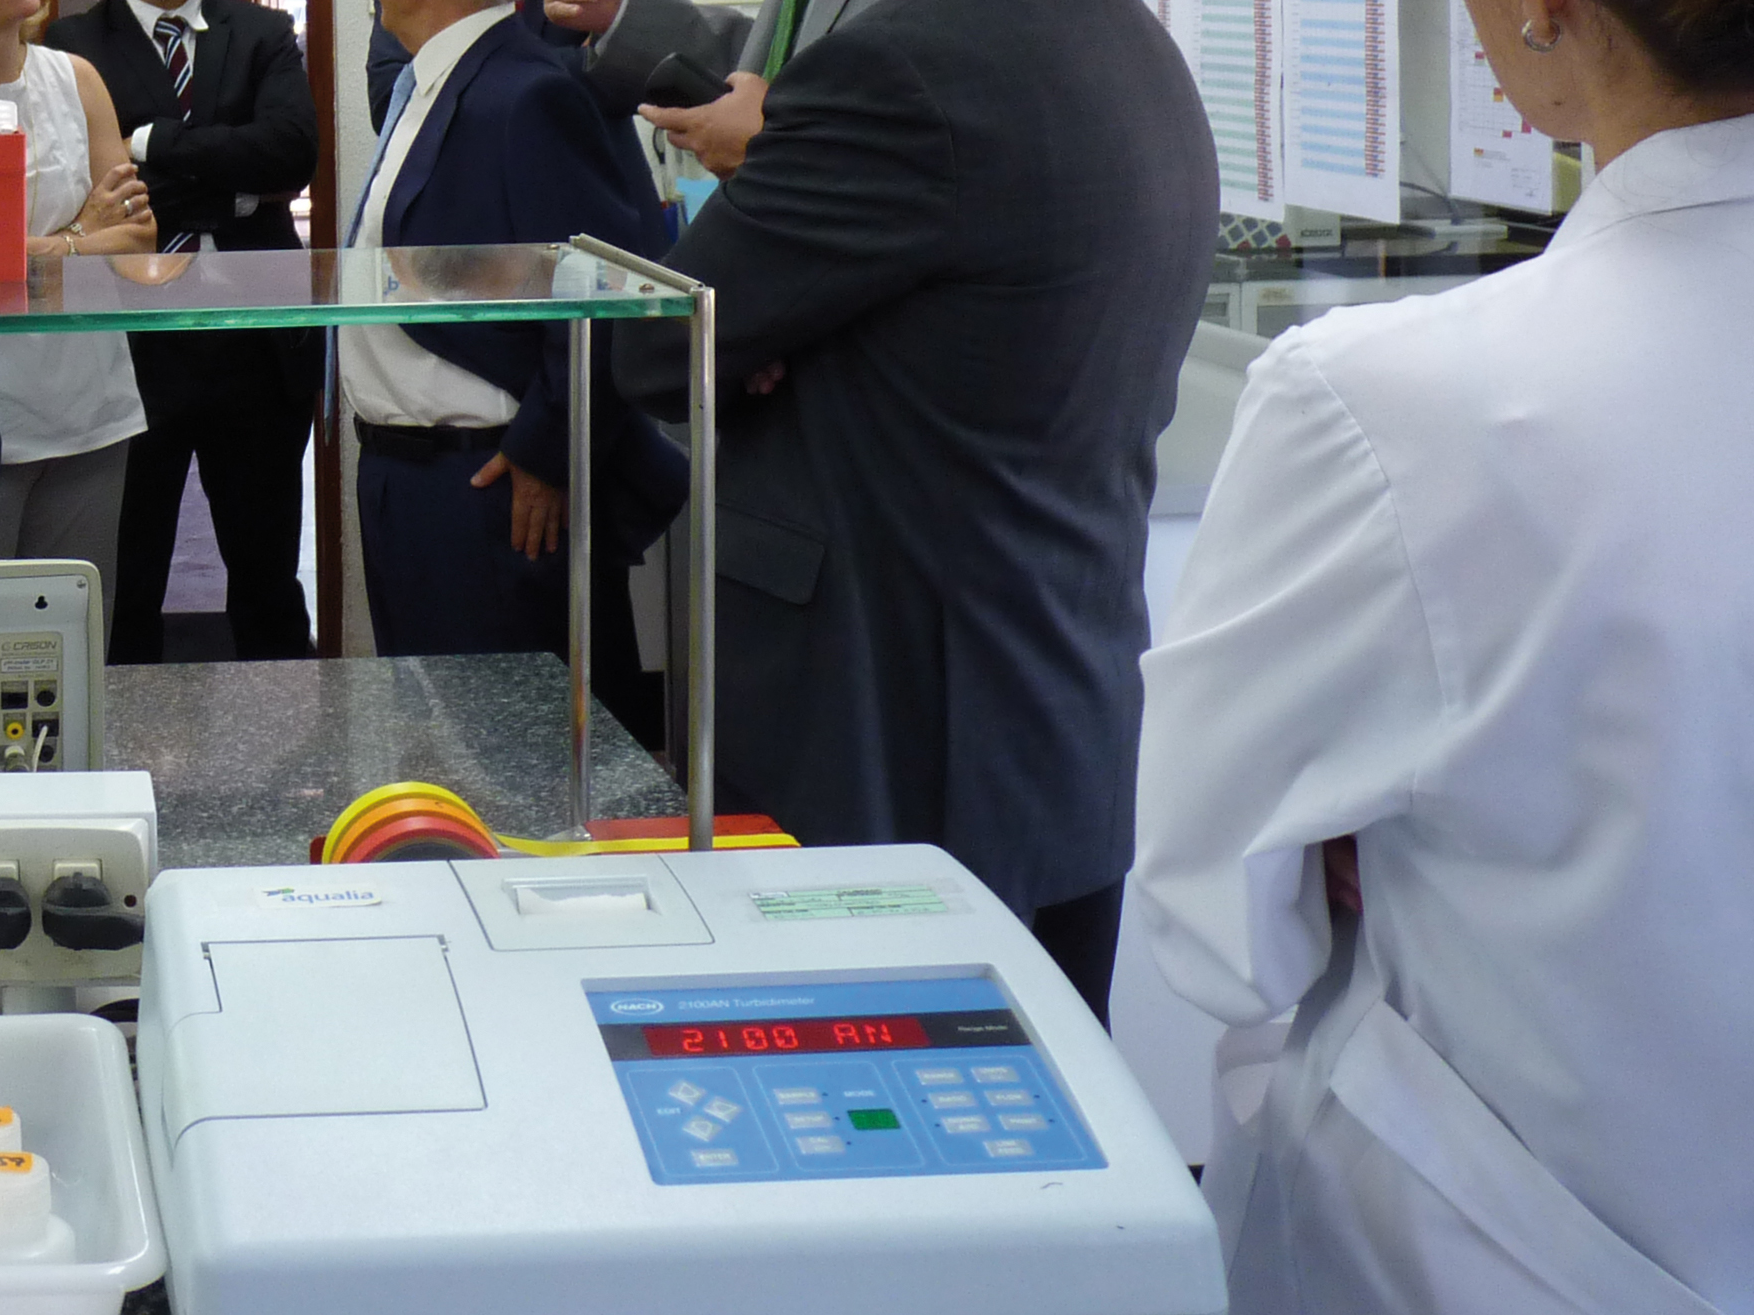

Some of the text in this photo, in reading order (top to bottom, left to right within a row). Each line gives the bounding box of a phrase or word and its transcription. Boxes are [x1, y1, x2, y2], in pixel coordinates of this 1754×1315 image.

[13, 641, 57, 651] CRISON
[282, 890, 374, 904] aqualia
[618, 1001, 658, 1011] HACH
[679, 996, 815, 1010] 2100AN Turbidimeter
[833, 1023, 893, 1045] AN
